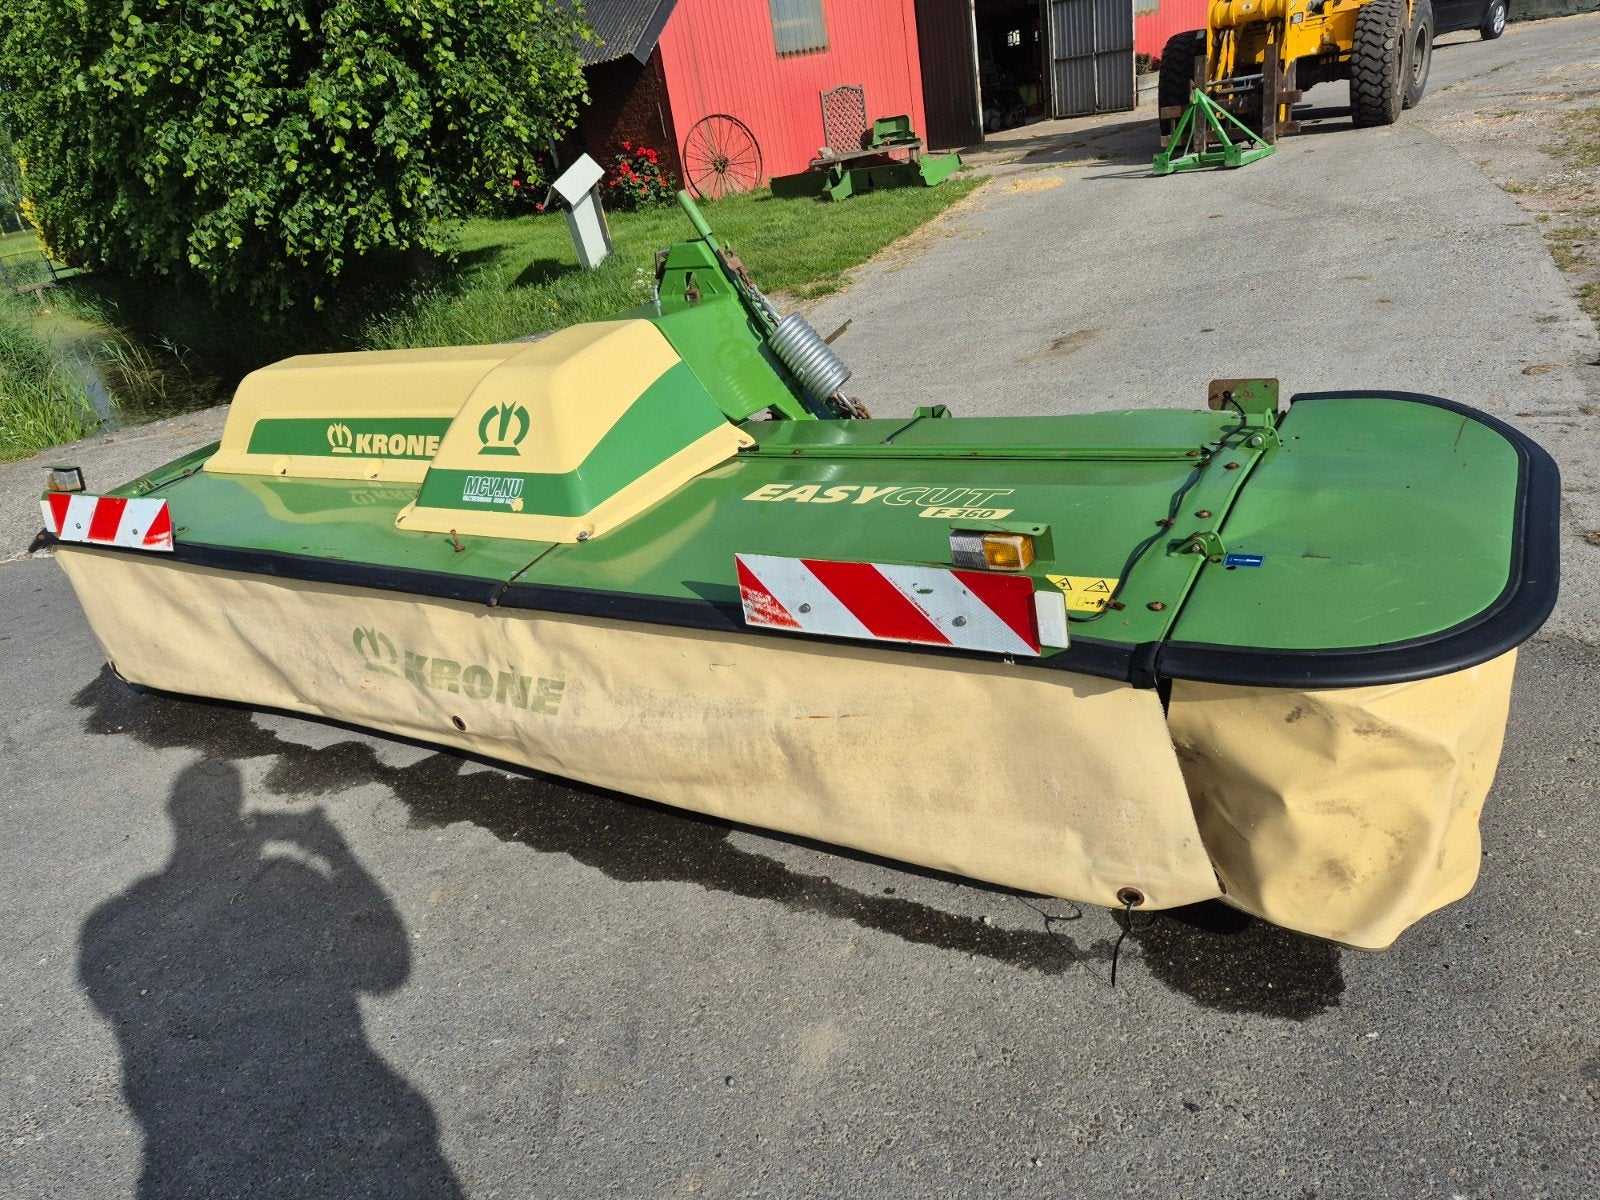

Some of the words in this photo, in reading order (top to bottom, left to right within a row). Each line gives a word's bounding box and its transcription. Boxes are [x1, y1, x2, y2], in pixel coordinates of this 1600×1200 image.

[355, 433, 440, 457] KRONE
[463, 475, 525, 499] MCV.NU
[931, 508, 950, 517] F
[954, 509, 996, 519] 360
[404, 650, 566, 716] KRONE
